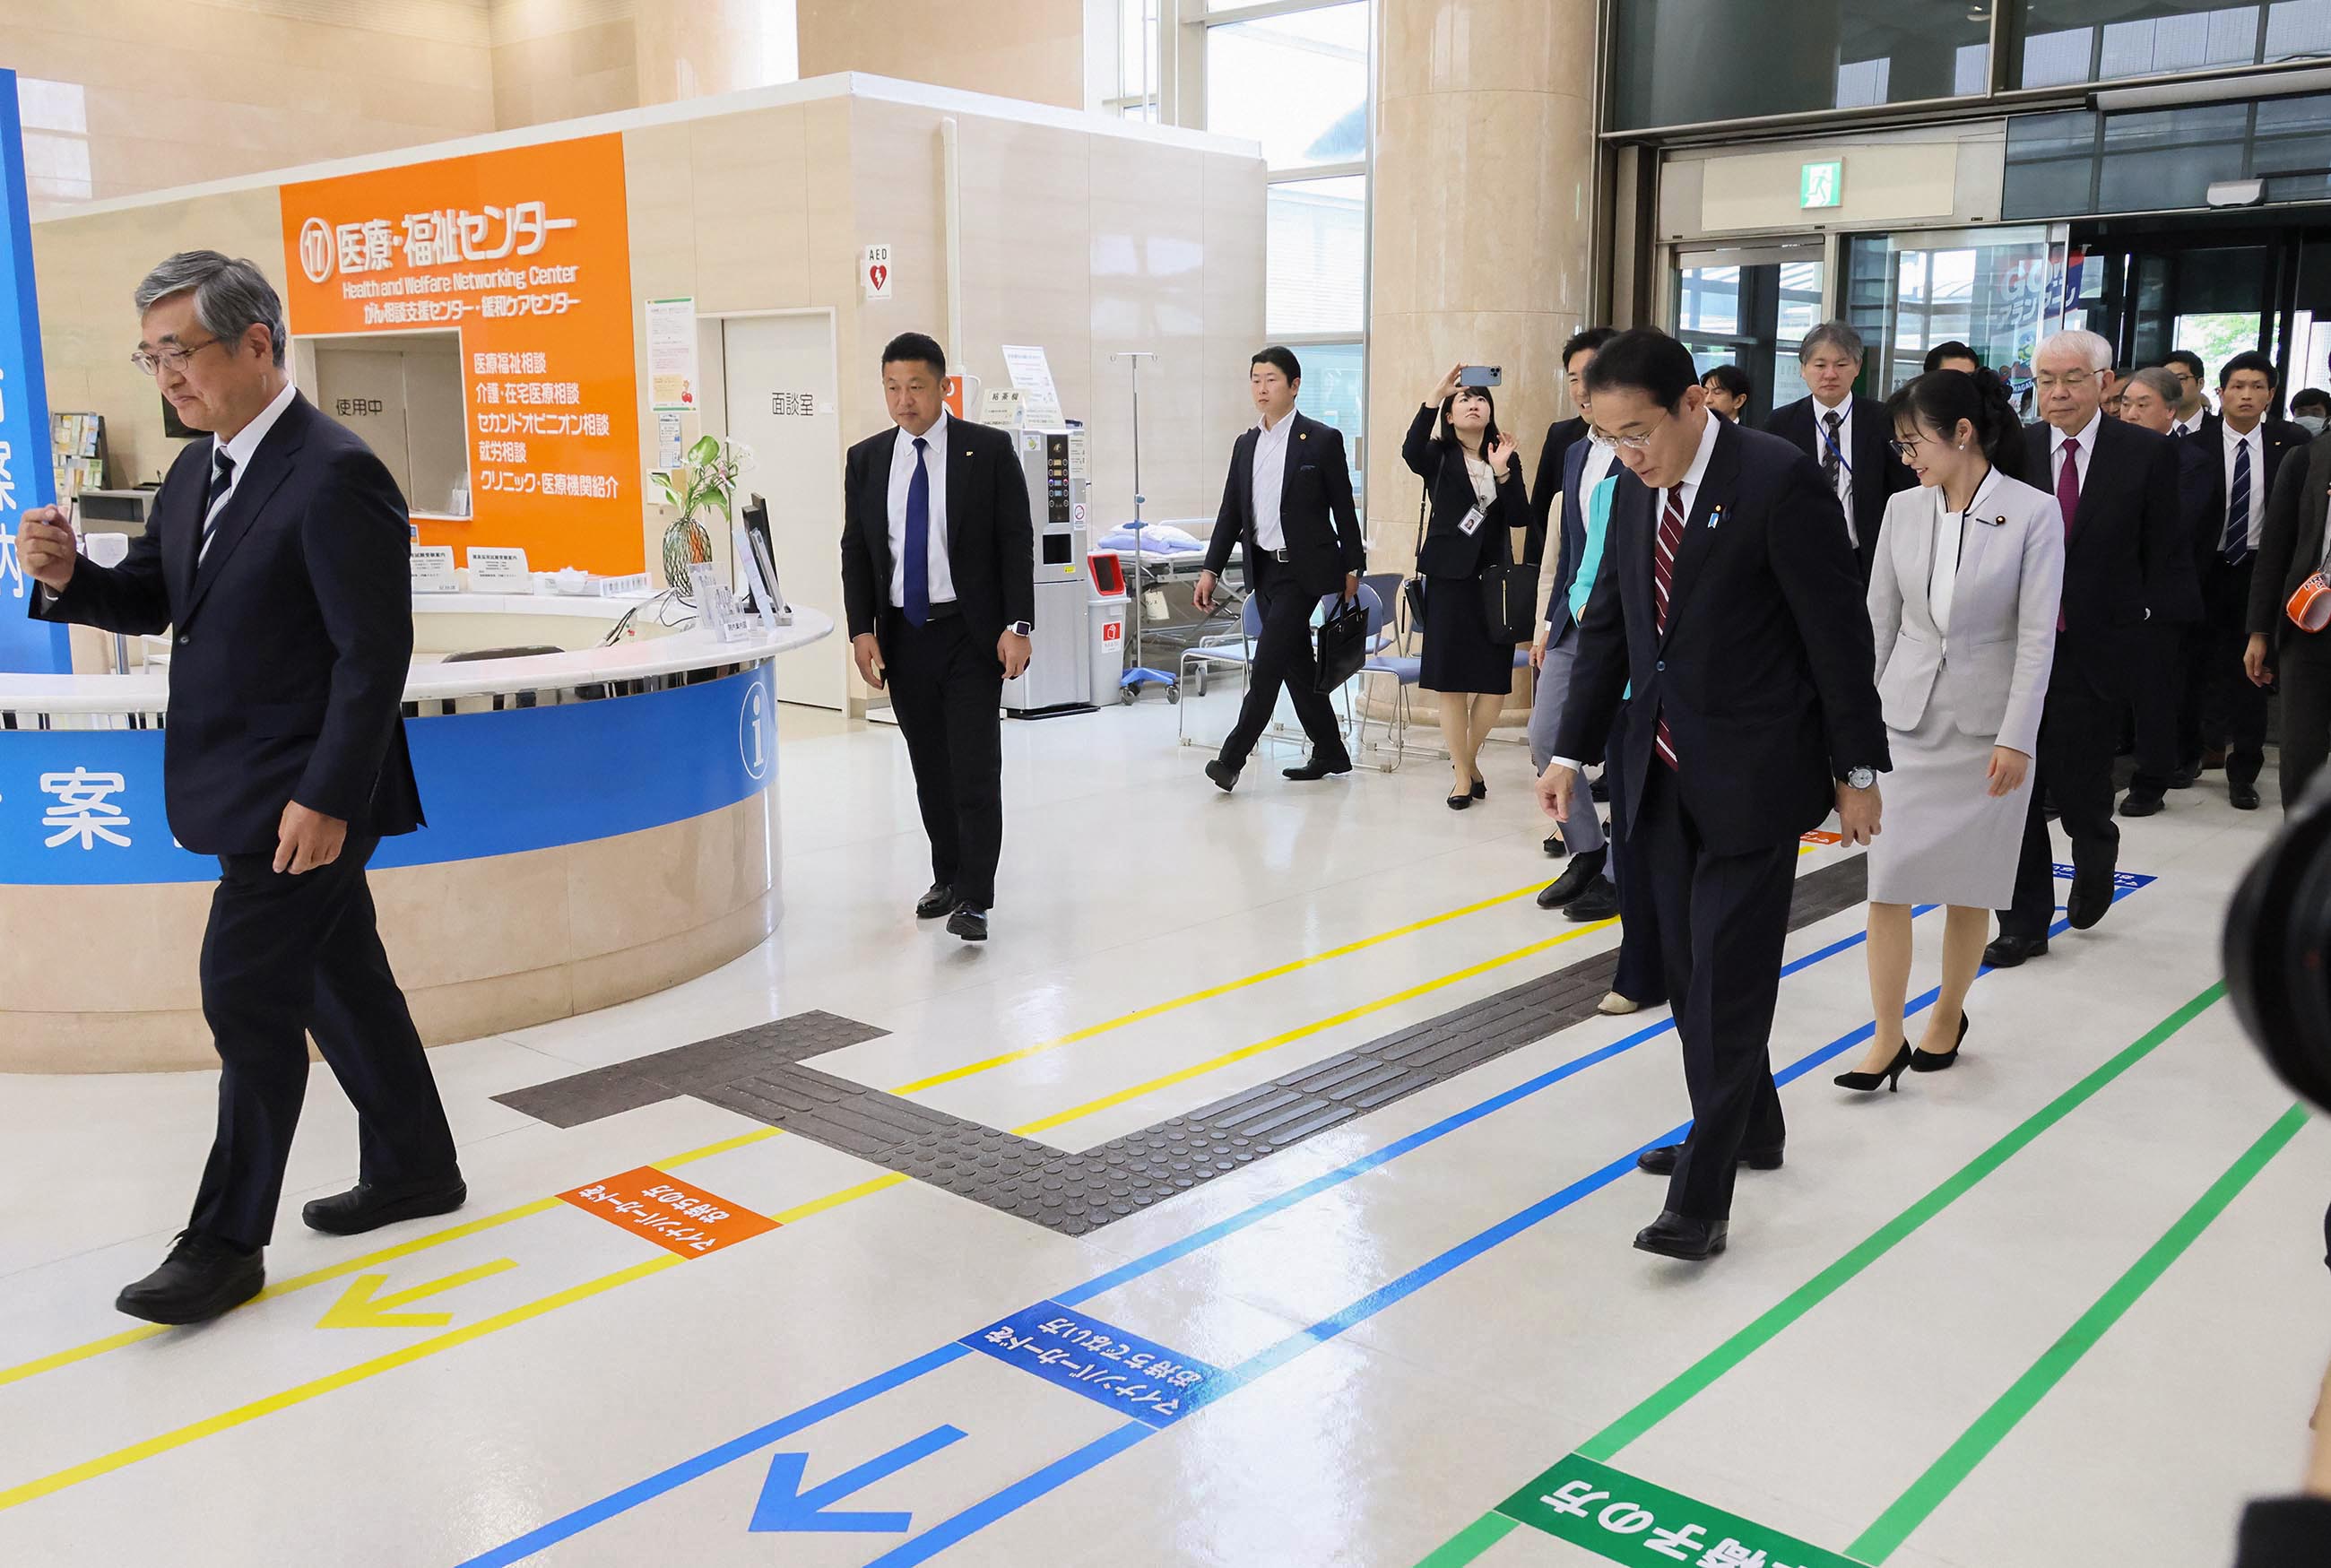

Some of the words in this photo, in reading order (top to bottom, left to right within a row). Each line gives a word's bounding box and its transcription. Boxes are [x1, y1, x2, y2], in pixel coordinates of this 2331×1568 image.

[335, 201, 577, 274] 医療・福祉センター
[869, 247, 887, 261] AED
[342, 280, 380, 299] Health
[381, 277, 403, 296] and
[404, 274, 452, 295] Welfare
[453, 267, 527, 290] Networking
[529, 264, 580, 285] Center
[364, 291, 582, 325] がん相談支援センター・緩和ケアセンター
[473, 351, 547, 374] 医療福祉相談
[335, 398, 383, 417] 使用中
[476, 382, 581, 404] 介護・在宅医療相談
[772, 392, 813, 416] 面談室
[477, 411, 611, 437] セカンドオピニオン相談
[478, 440, 527, 463] 就労相談
[481, 470, 620, 499] クリニック・医療機関紹介
[578, 1184, 716, 1252] マイナンバーカードを
[641, 1184, 731, 1225] お持ちの方
[1037, 1317, 1204, 1388] お持ちでない方
[984, 1325, 1180, 1416] マイナンバーカードを
[1539, 1479, 1809, 1568] 椅子の方
